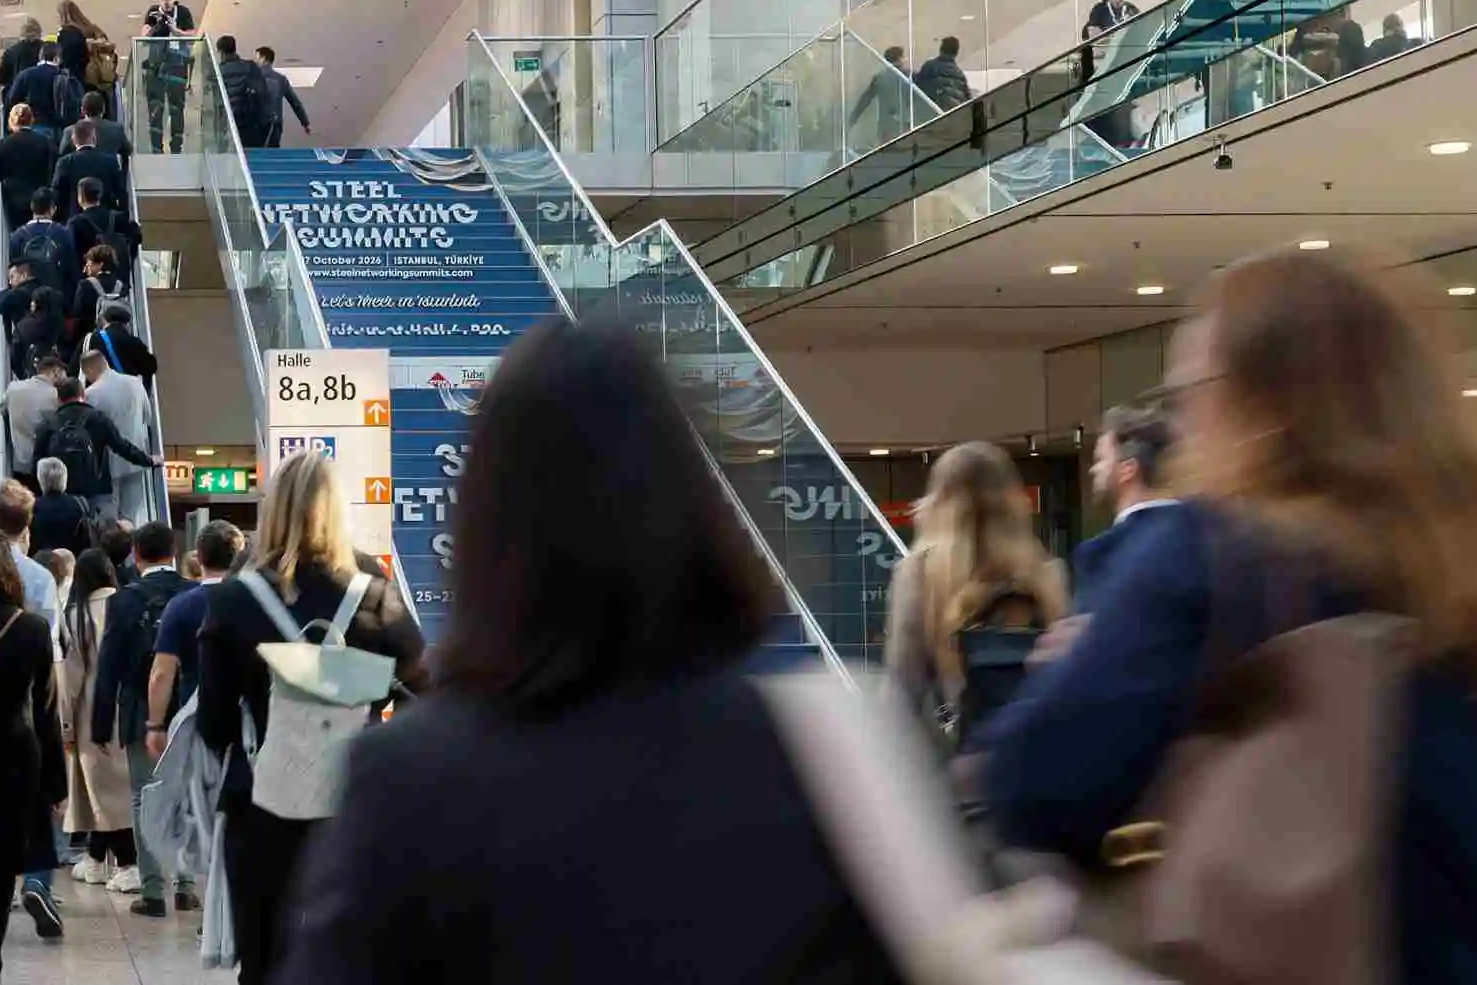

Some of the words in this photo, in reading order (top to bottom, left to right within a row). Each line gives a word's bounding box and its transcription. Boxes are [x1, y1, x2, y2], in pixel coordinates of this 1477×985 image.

[308, 180, 402, 199] STEEL
[296, 227, 454, 248] SUMMITS
[312, 255, 356, 265] October
[358, 255, 382, 265] 2026
[278, 353, 311, 367] Halle
[279, 374, 356, 404] 8a,8b
